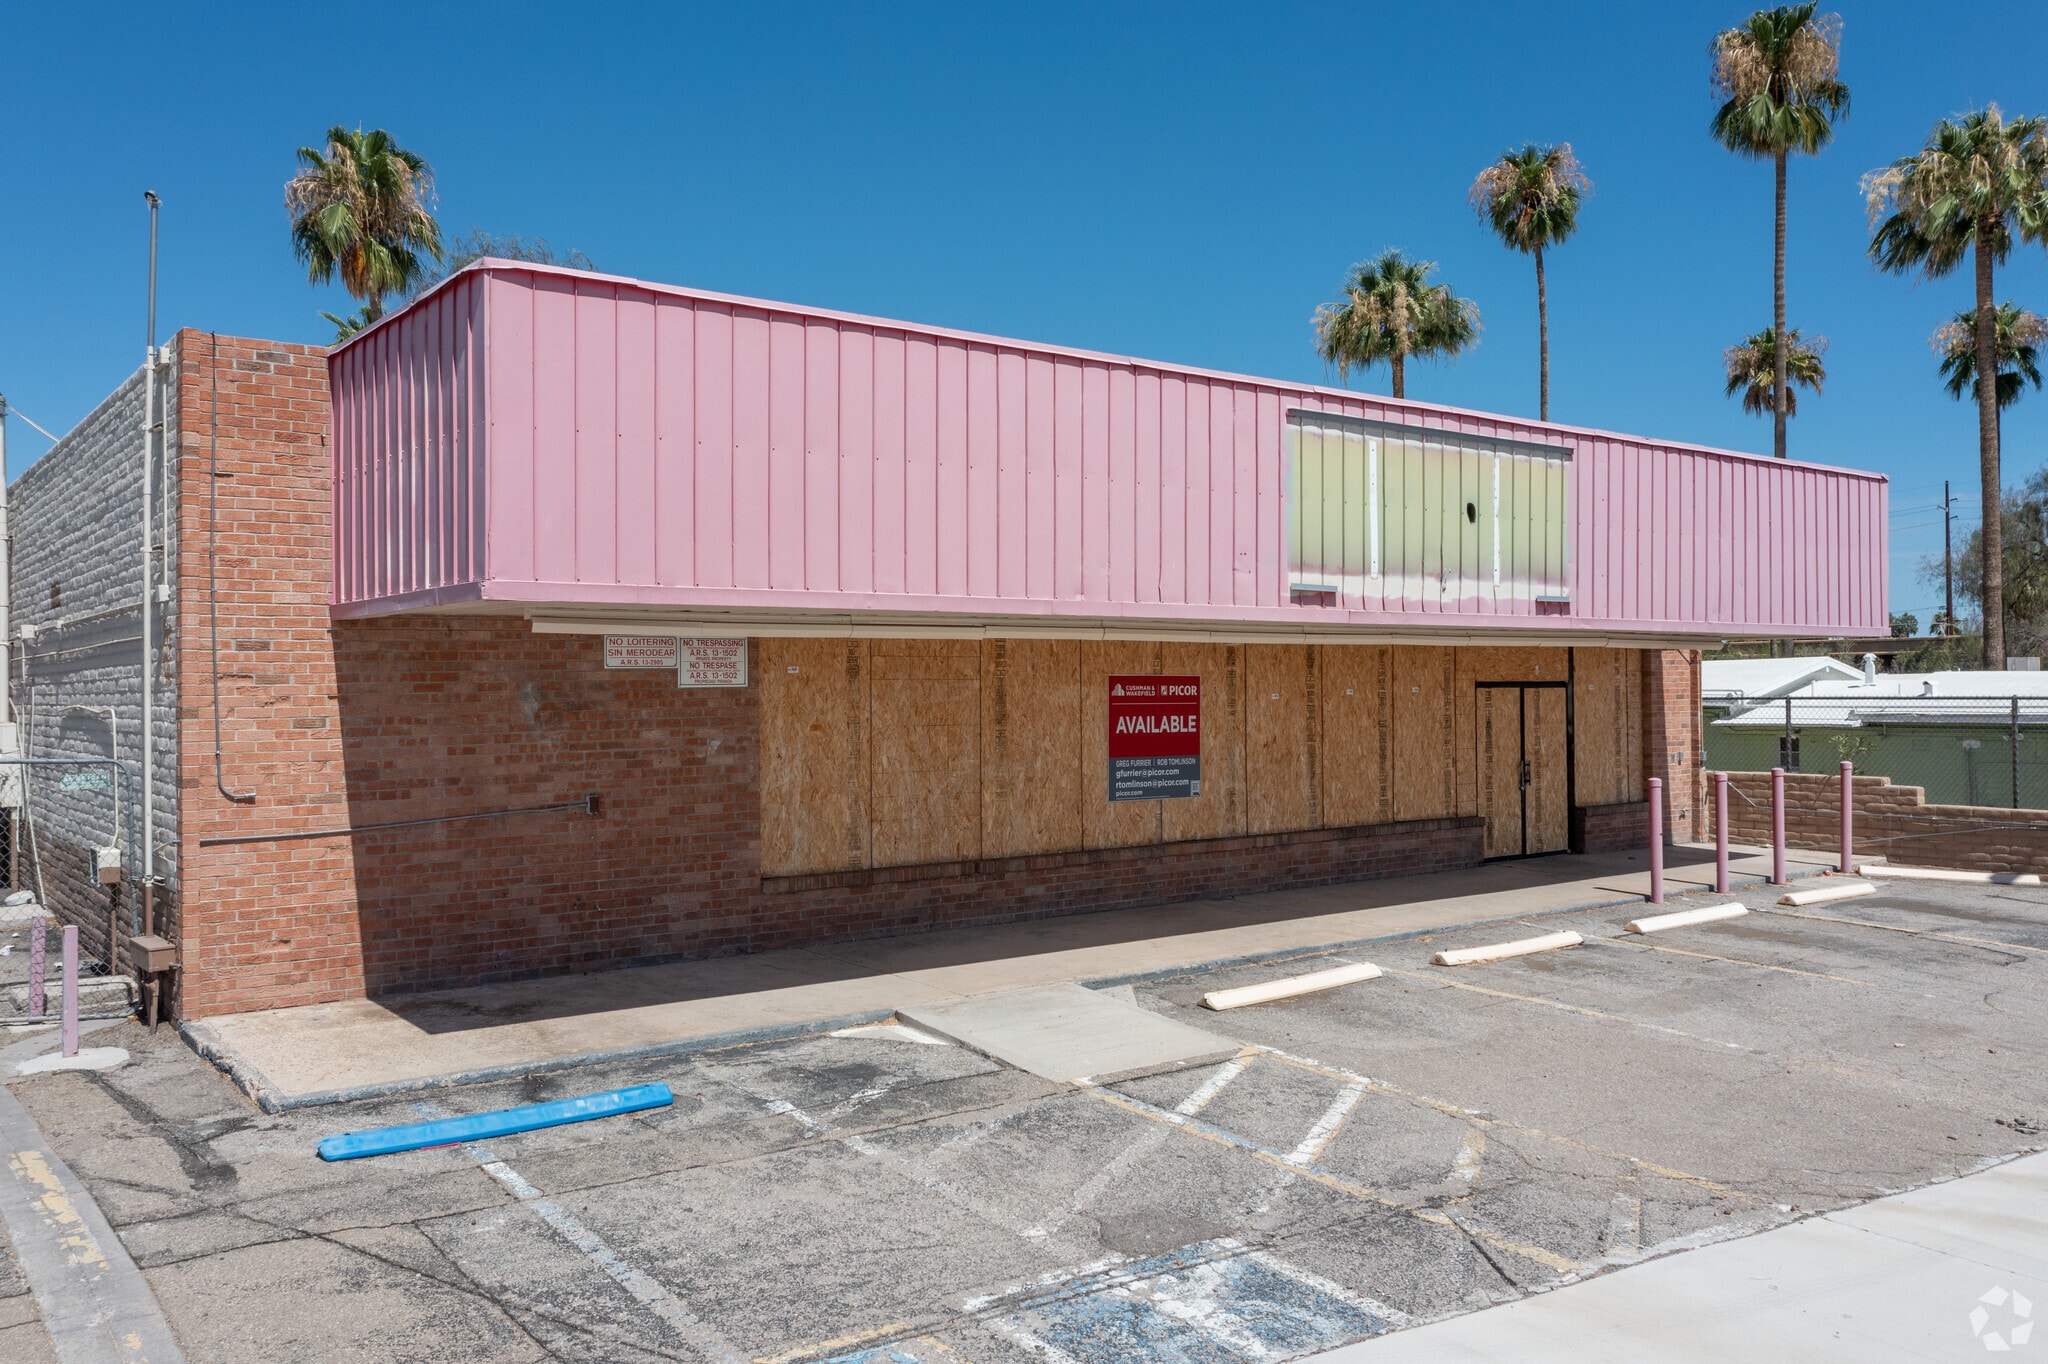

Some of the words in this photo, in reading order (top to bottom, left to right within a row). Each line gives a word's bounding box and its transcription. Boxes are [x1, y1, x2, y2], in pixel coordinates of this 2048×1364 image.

[609, 638, 623, 646] NO
[627, 638, 674, 646] LOITERING
[683, 639, 694, 647] NO
[697, 639, 744, 647] TRESPASSING
[608, 649, 623, 657] SIN
[626, 649, 675, 657] MERODEAR
[1169, 685, 1198, 696] PICOR
[1116, 715, 1197, 734] AVAILABLE
[1130, 759, 1152, 767] FURRIER
[1116, 768, 1180, 778] gfurrier@picor.com
[1116, 779, 1189, 789] rtomlinson@picor.com
